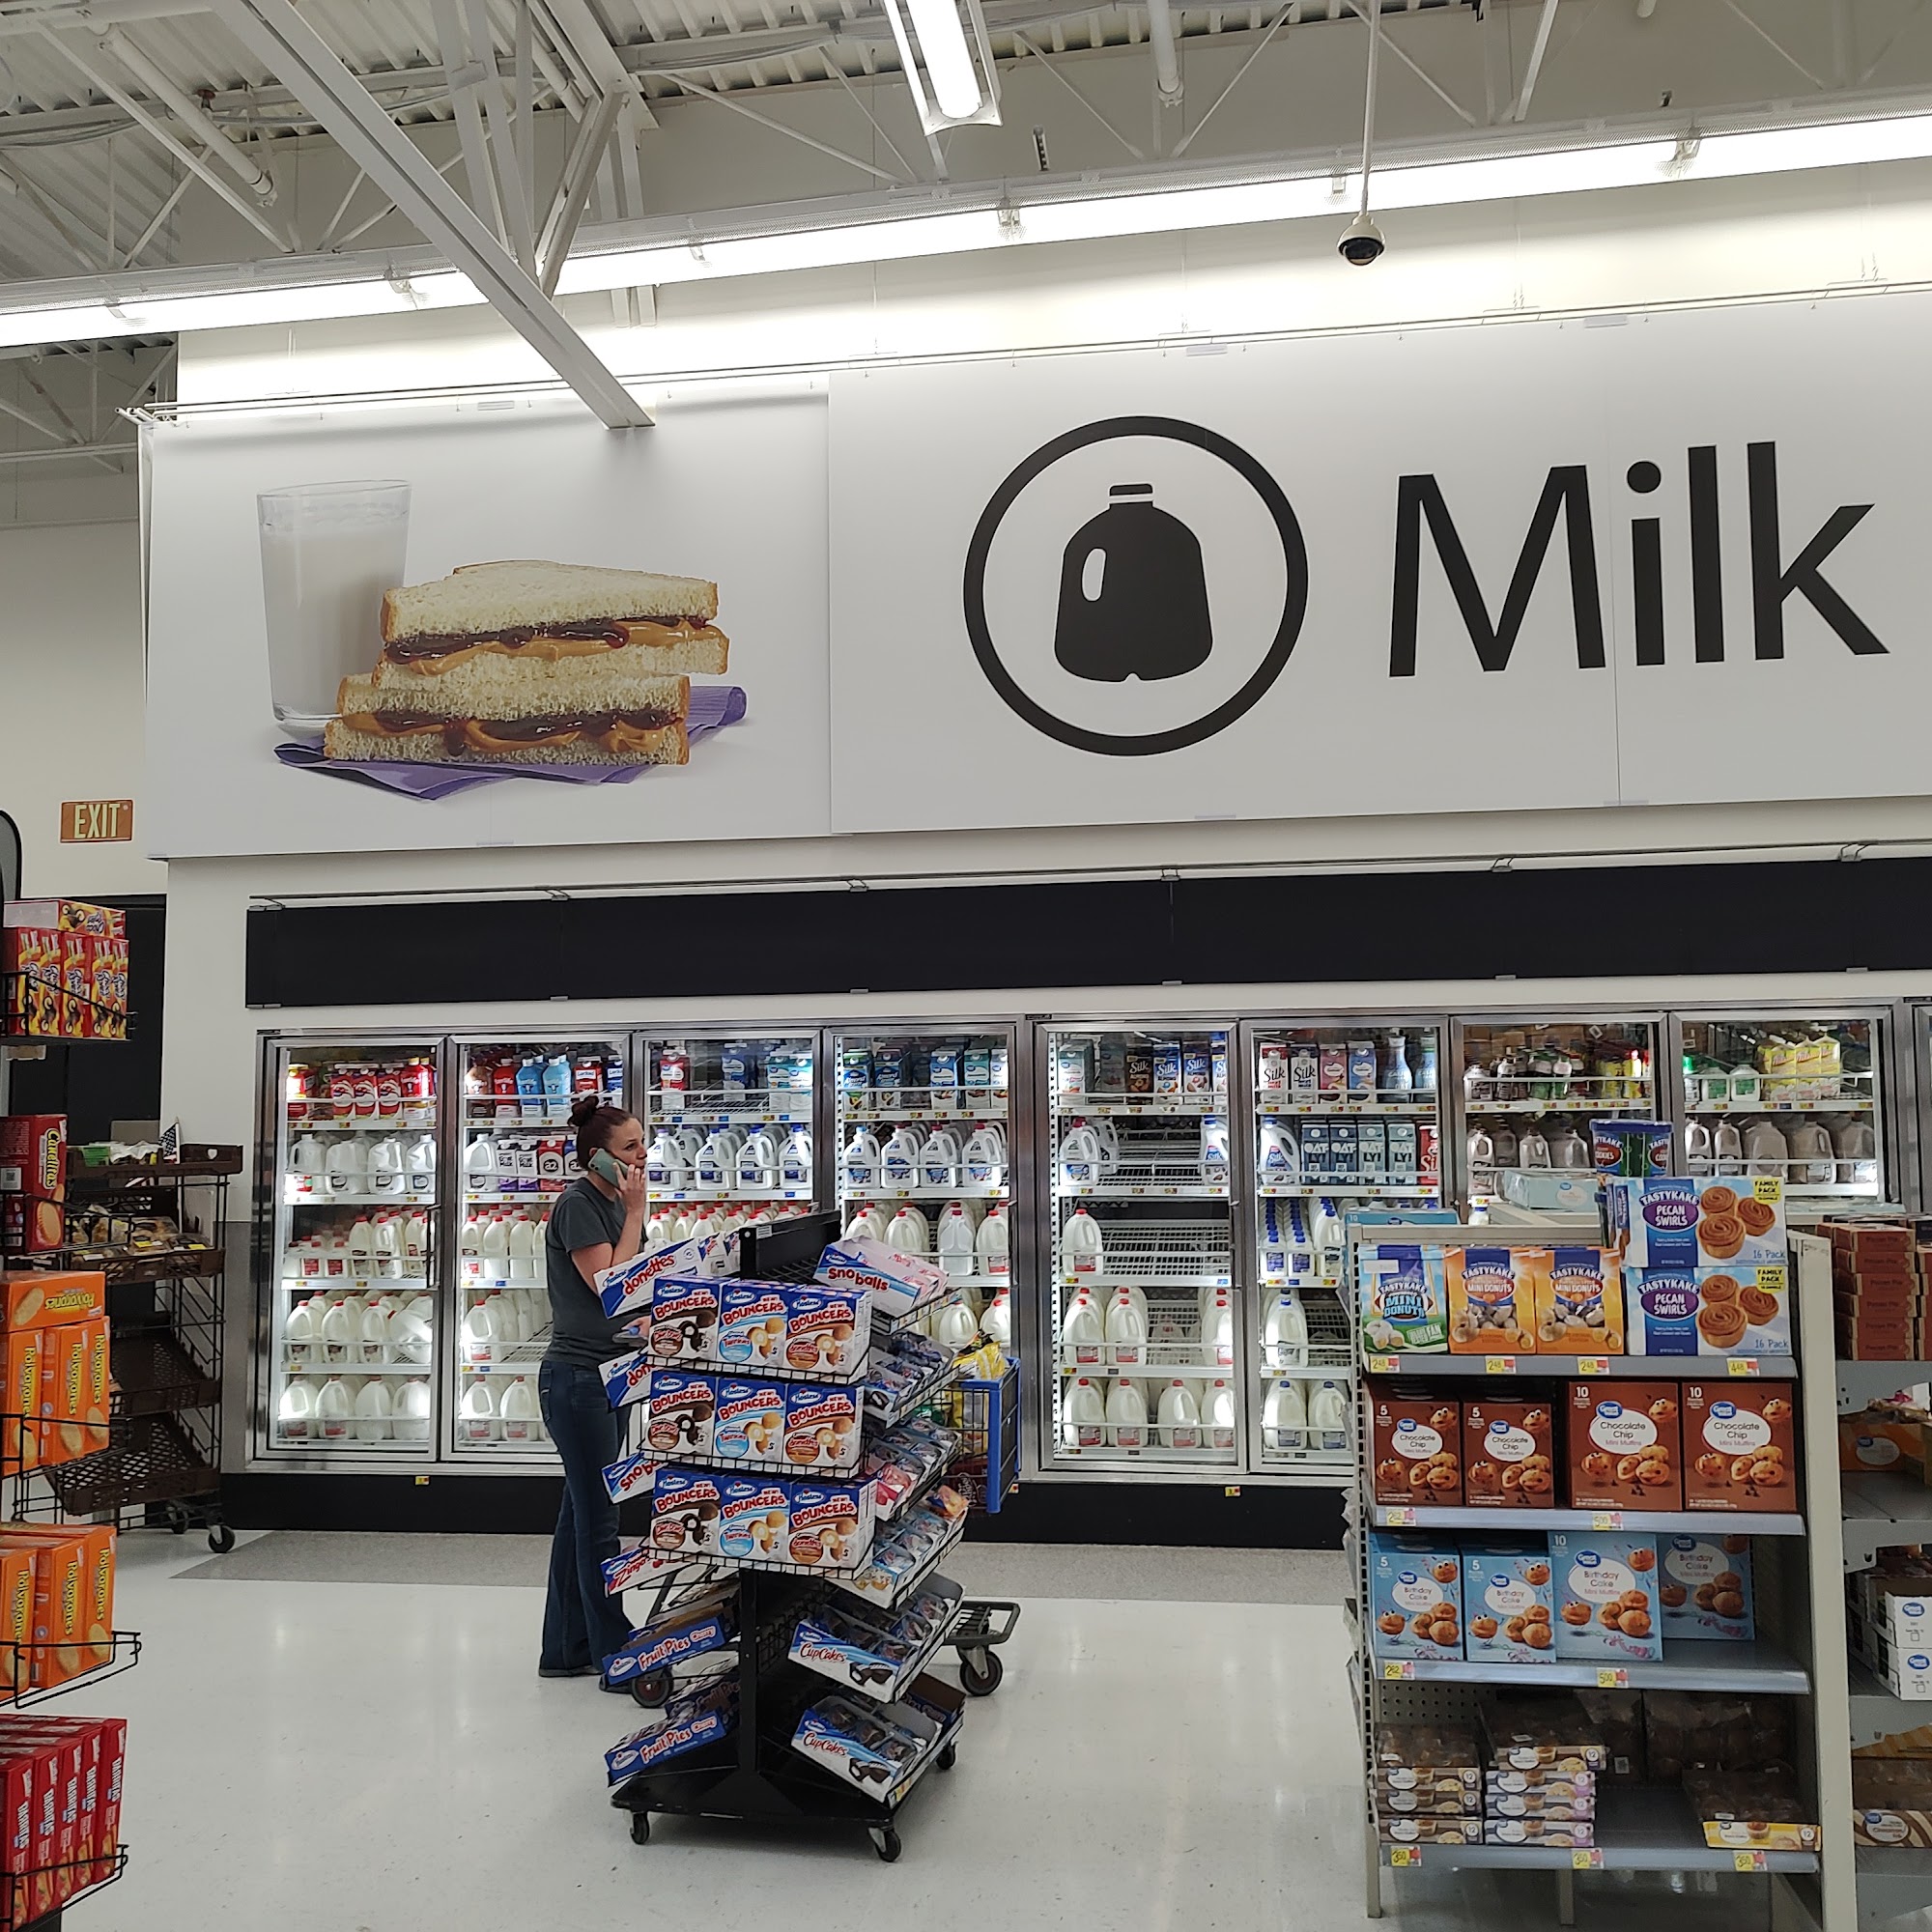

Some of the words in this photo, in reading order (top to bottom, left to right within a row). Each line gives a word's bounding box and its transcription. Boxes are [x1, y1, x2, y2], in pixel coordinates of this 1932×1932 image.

[1388, 440, 1890, 678] Milk
[74, 803, 121, 838] EXIT
[1129, 1063, 1150, 1074] Silk
[1156, 1064, 1177, 1076] Silk
[1186, 1059, 1207, 1071] Silk
[1264, 1067, 1286, 1082] Silk
[1293, 1066, 1316, 1081] Silk
[1304, 1142, 1329, 1153] OAT
[1331, 1142, 1356, 1153] OAT
[1359, 1142, 1384, 1153] OAT
[1389, 1142, 1414, 1153] OAT
[45, 1129, 62, 1188] Canelitas
[1363, 1152, 1381, 1162] LY!
[1394, 1152, 1412, 1162] LY!
[545, 1161, 558, 1171] a2
[1640, 1191, 1700, 1207] TASTYKAKE
[1656, 1205, 1686, 1215] PECAN
[1655, 1214, 1688, 1227] SWIRLS
[1753, 1249, 1762, 1259] 16
[1765, 1249, 1786, 1259] Pack
[623, 1255, 675, 1295] donettes
[1463, 1265, 1516, 1279] TASTYKAKE
[1550, 1265, 1605, 1280] TASTYKAKE
[1379, 1282, 1428, 1293] TASTYKAKE
[1467, 1284, 1484, 1293] MINI
[1485, 1284, 1513, 1293] DONUTS
[1555, 1284, 1572, 1293] MINI
[1573, 1284, 1601, 1293] DONUTS
[1638, 1279, 1700, 1294] TASTYKAKE
[1385, 1295, 1423, 1307] MINI
[1655, 1293, 1686, 1304] PECAN
[655, 1296, 715, 1319] BOUNCERS
[723, 1302, 784, 1324] BOUNCERS
[1384, 1305, 1426, 1318] DONUTS
[1654, 1304, 1688, 1316] SWIRLS
[790, 1309, 852, 1331] BOUNCERS
[1755, 1340, 1764, 1349] 16
[1768, 1339, 1789, 1349] Pack
[93, 1334, 105, 1405] Polvorones
[68, 1342, 83, 1415] Polvorones
[1576, 1386, 1589, 1398] 10
[1690, 1386, 1702, 1398] 10
[652, 1390, 711, 1412] BOUNCERS
[720, 1397, 781, 1420] BOUNCERS
[789, 1402, 851, 1426] BOUNCERS
[1380, 1405, 1388, 1416] 5
[1472, 1406, 1481, 1417] 5
[1600, 1421, 1646, 1430] Chocolate
[1612, 1430, 1634, 1439] Chip
[1726, 1431, 1747, 1439] Chip
[657, 1489, 717, 1512] BOUNCERS
[724, 1495, 785, 1519] BOUNCERS
[792, 1502, 855, 1526] BOUNCERS
[1554, 1535, 1567, 1546] 10
[1380, 1556, 1388, 1567] 5
[1472, 1560, 1480, 1571] 5
[1583, 1571, 1619, 1581] Birthday
[96, 1548, 110, 1621] Polvorones
[64, 1560, 78, 1635] Polvorones
[639, 1645, 667, 1670] Fruit
[665, 1637, 690, 1655] Pies
[640, 1738, 667, 1764] Fruit
[666, 1729, 692, 1747] Pies
